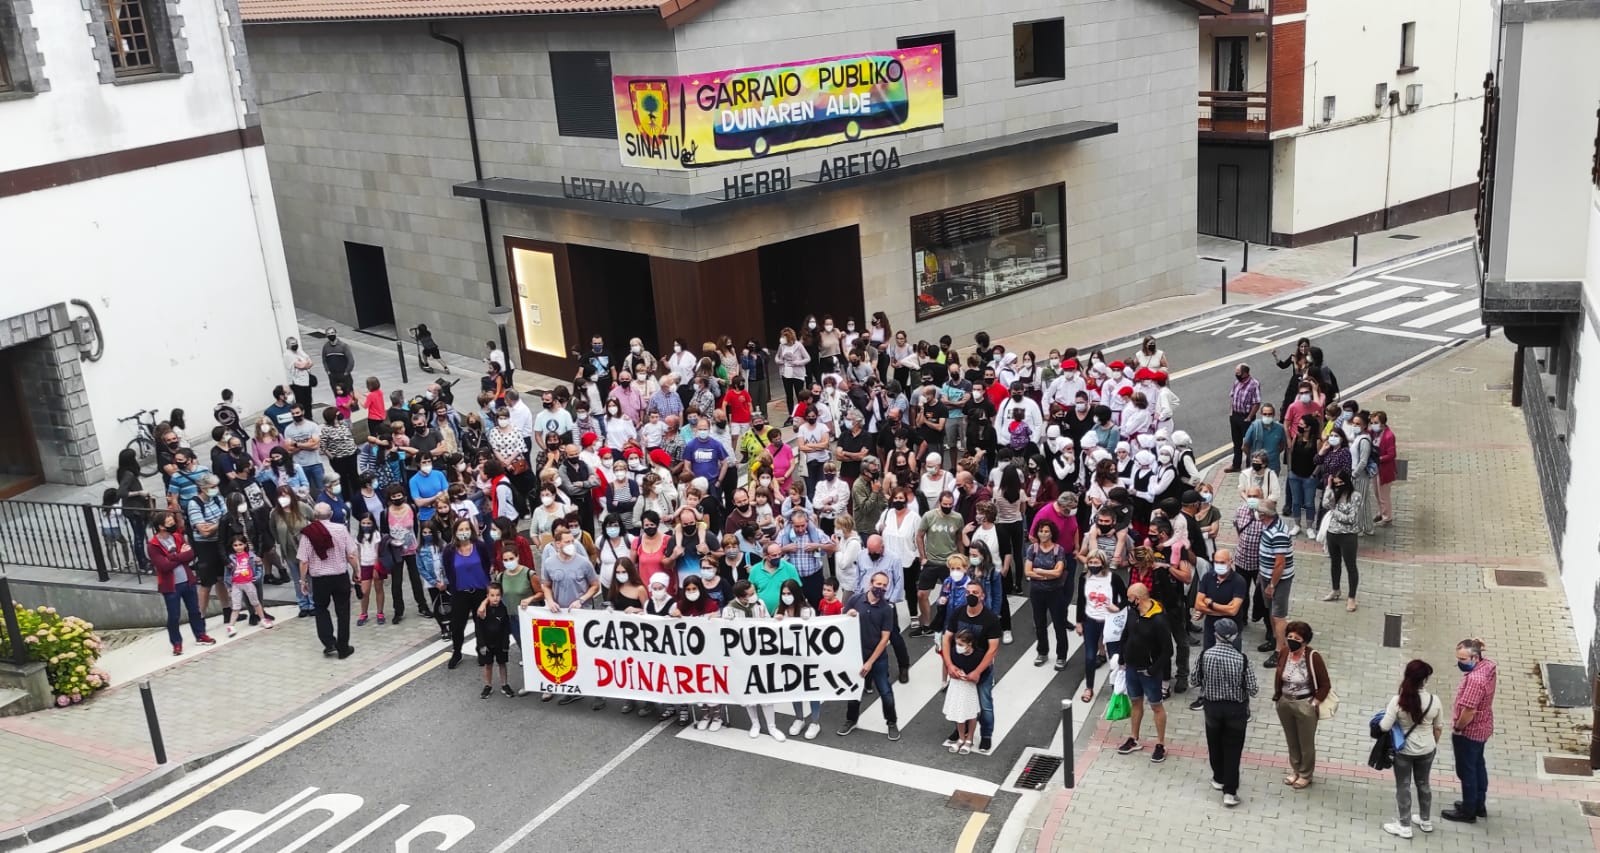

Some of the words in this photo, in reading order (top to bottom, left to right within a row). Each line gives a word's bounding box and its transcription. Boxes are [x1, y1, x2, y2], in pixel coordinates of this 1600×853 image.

[696, 72, 801, 111] GARRAIO
[819, 58, 904, 89] PUBLIKO
[721, 101, 814, 131] DUINAREN
[826, 92, 871, 115] ALDE
[561, 176, 647, 205] LEITZAKO
[724, 166, 792, 201] HERRI
[818, 147, 901, 181] ARETOA
[1186, 317, 1297, 343] TAXI
